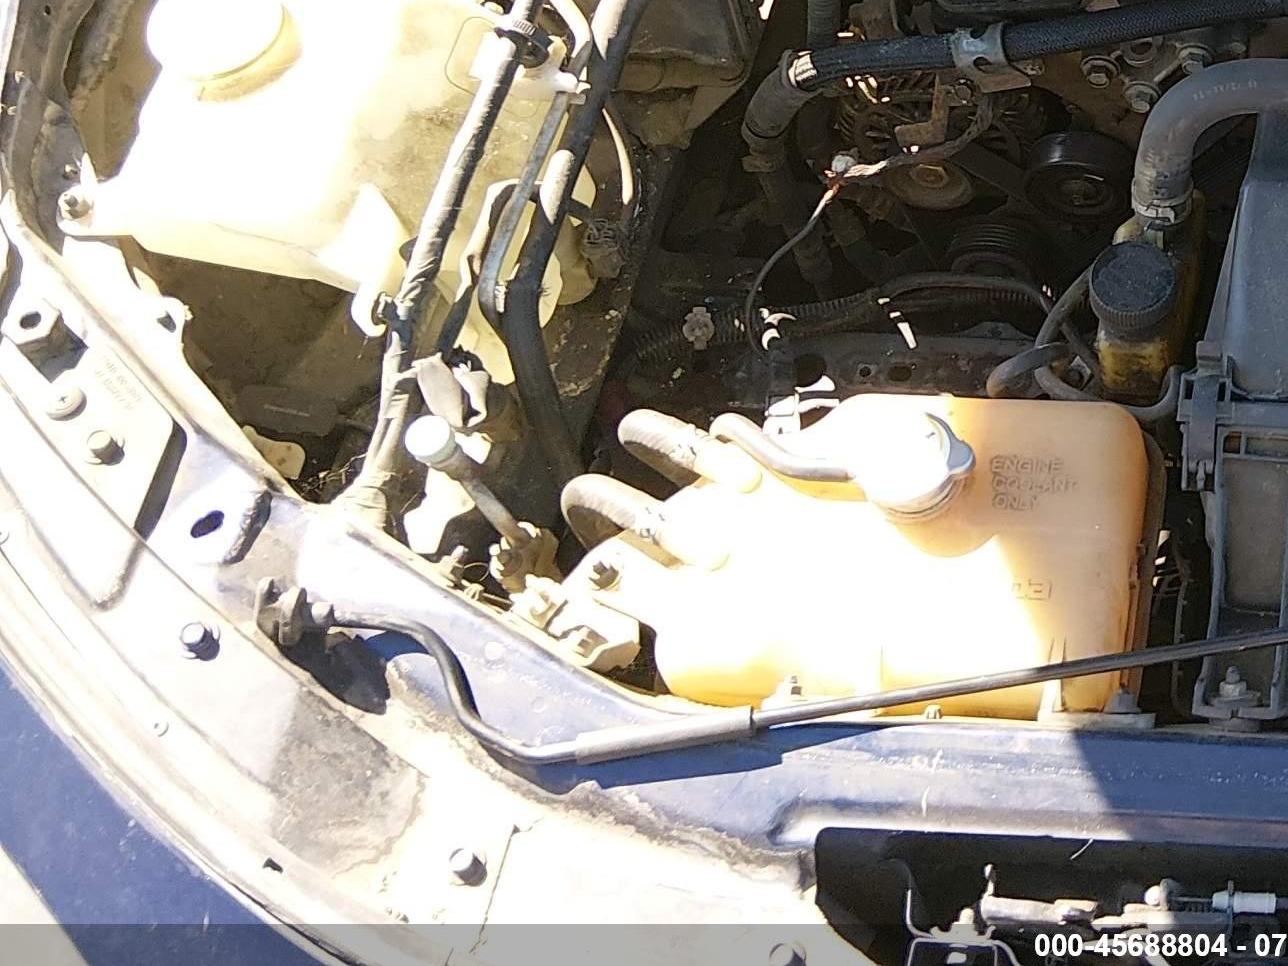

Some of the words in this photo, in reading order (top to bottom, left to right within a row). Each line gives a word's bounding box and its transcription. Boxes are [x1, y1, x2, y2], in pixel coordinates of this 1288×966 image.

[990, 455, 1065, 474] ENGINE
[991, 473, 1079, 494] COOLANT
[991, 492, 1040, 511] ONLY
